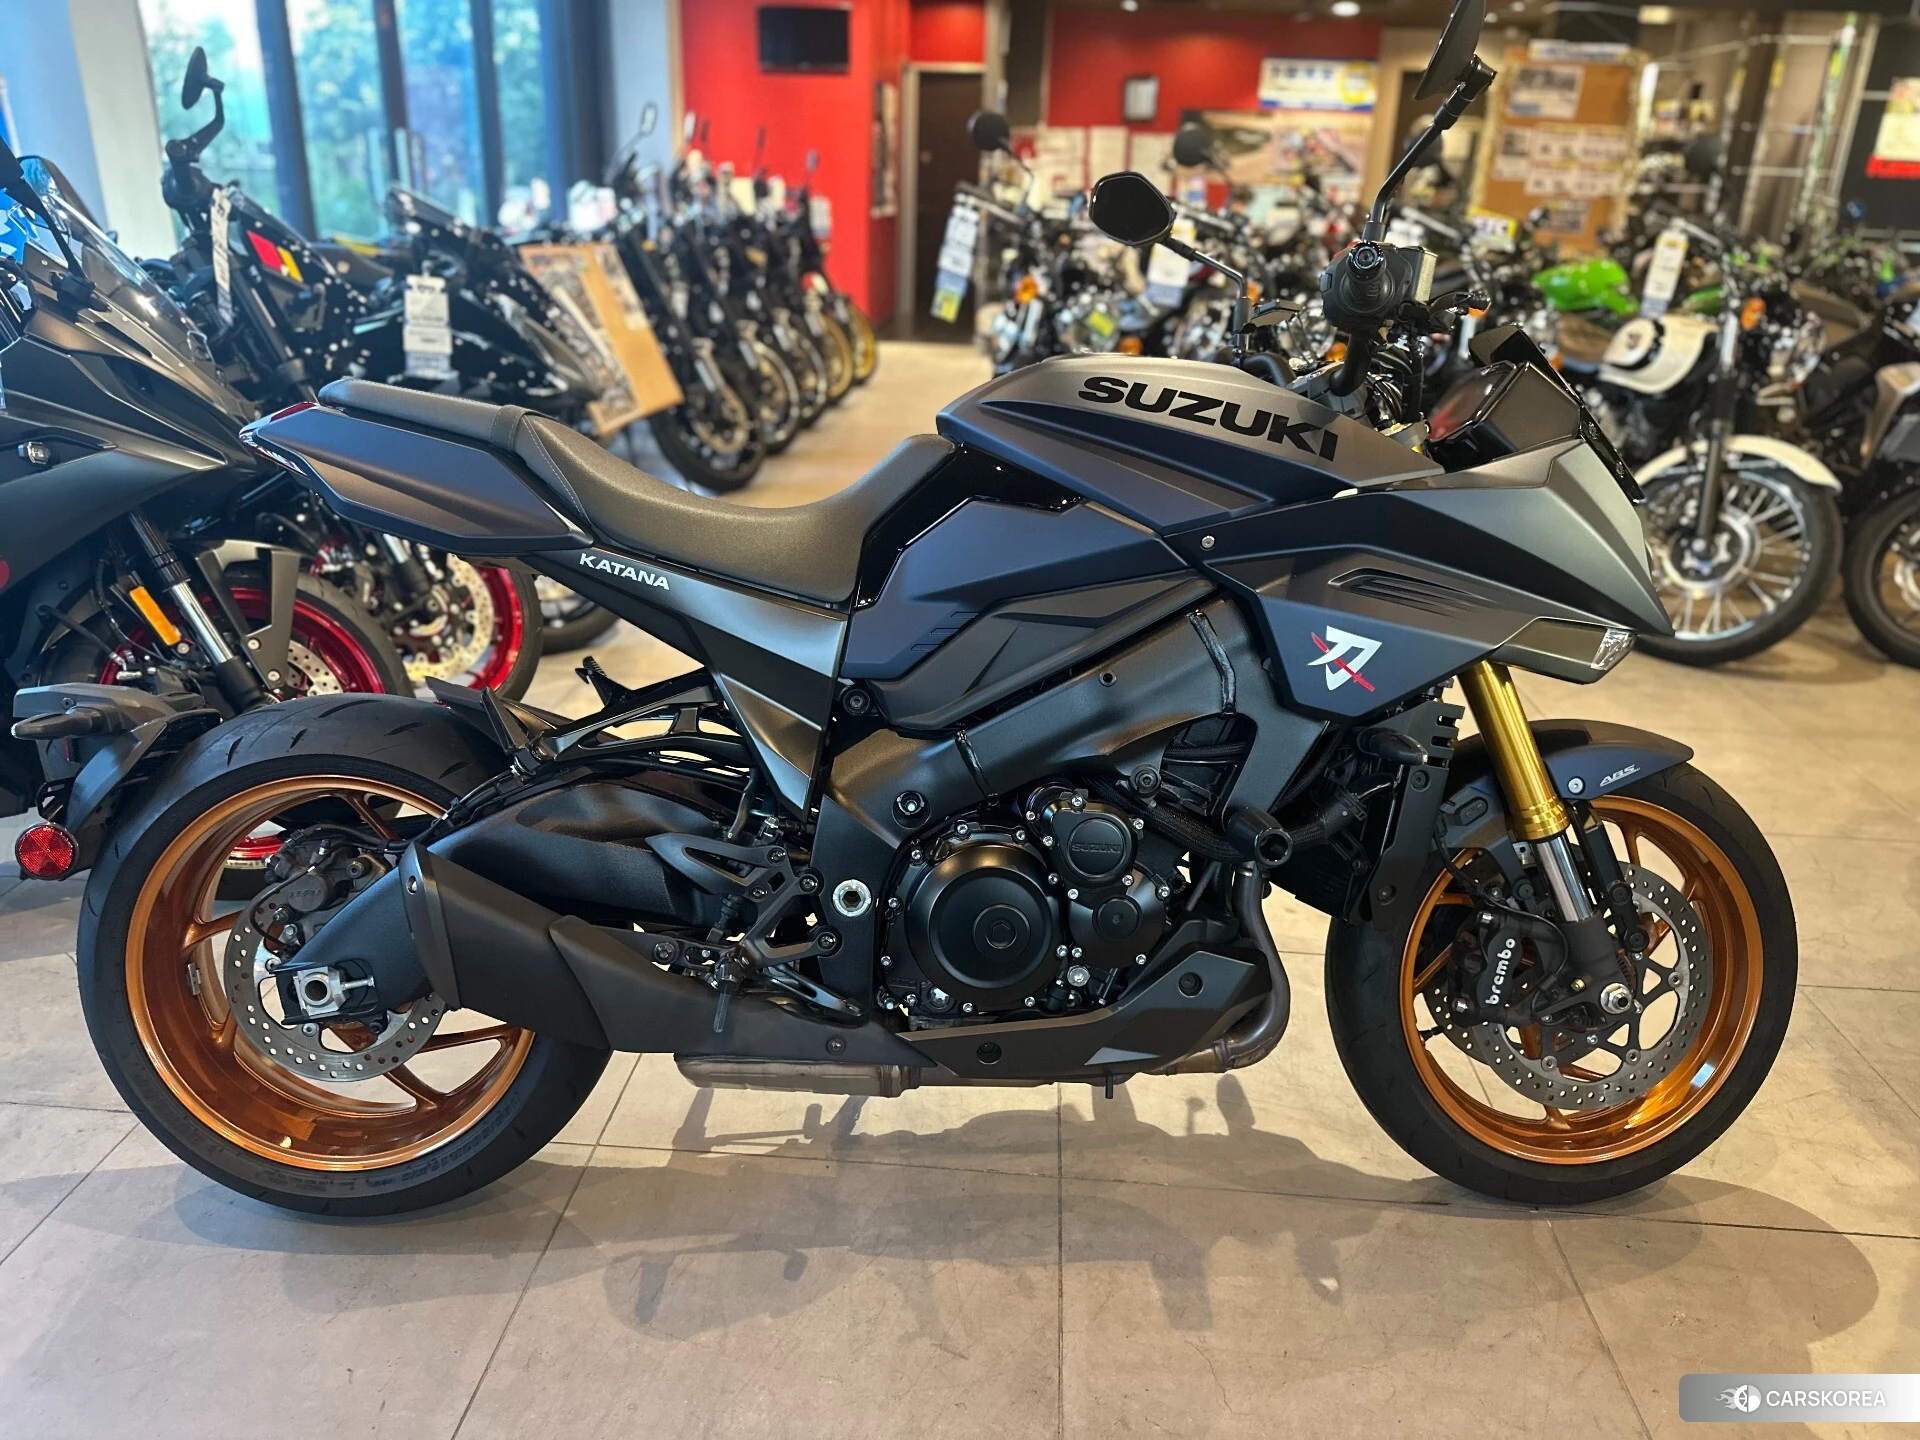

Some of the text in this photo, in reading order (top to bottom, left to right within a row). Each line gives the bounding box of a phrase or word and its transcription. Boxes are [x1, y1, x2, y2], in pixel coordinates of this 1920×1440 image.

[1078, 376, 1339, 462] SUZUKI
[579, 553, 670, 590] KATANA
[1600, 764, 1637, 787] ABS
[1071, 842, 1121, 854] SUZUKI
[1485, 938, 1516, 1005] brembo
